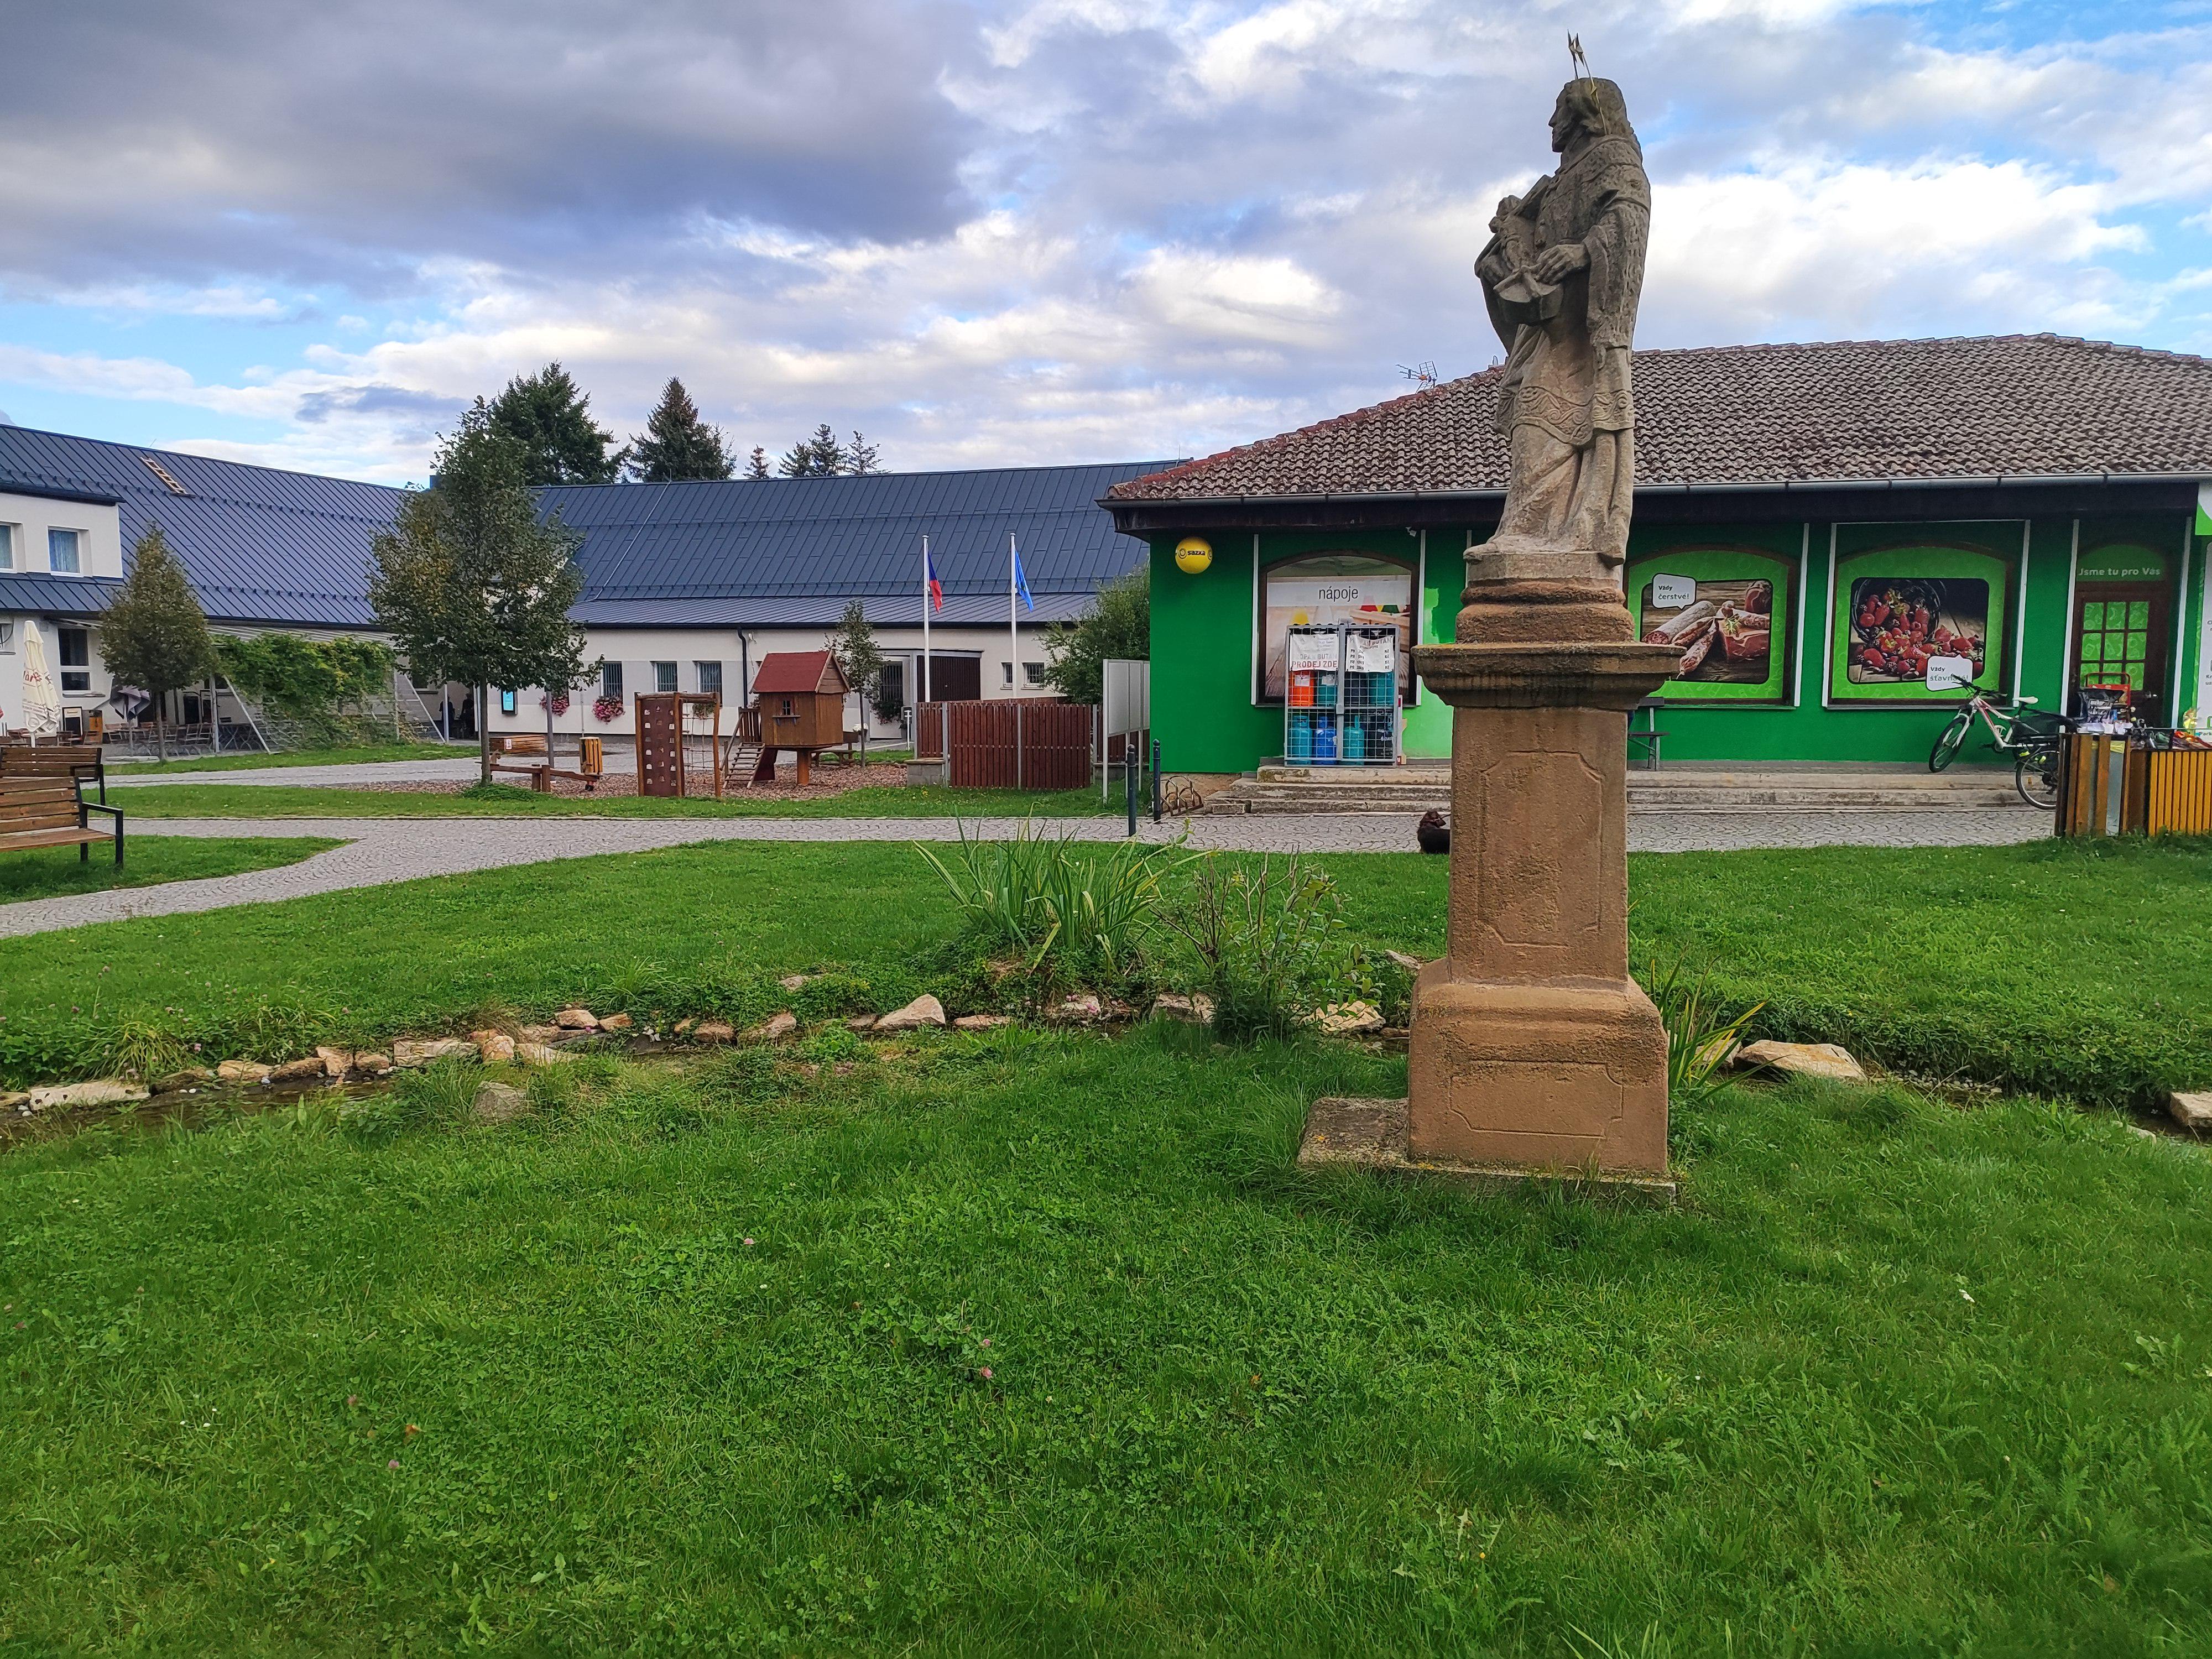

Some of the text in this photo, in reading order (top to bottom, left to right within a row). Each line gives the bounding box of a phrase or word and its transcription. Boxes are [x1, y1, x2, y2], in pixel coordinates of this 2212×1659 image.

[2121, 568, 2139, 577] pro
[2142, 567, 2161, 575] Vás
[1319, 586, 1358, 602] nápoje
